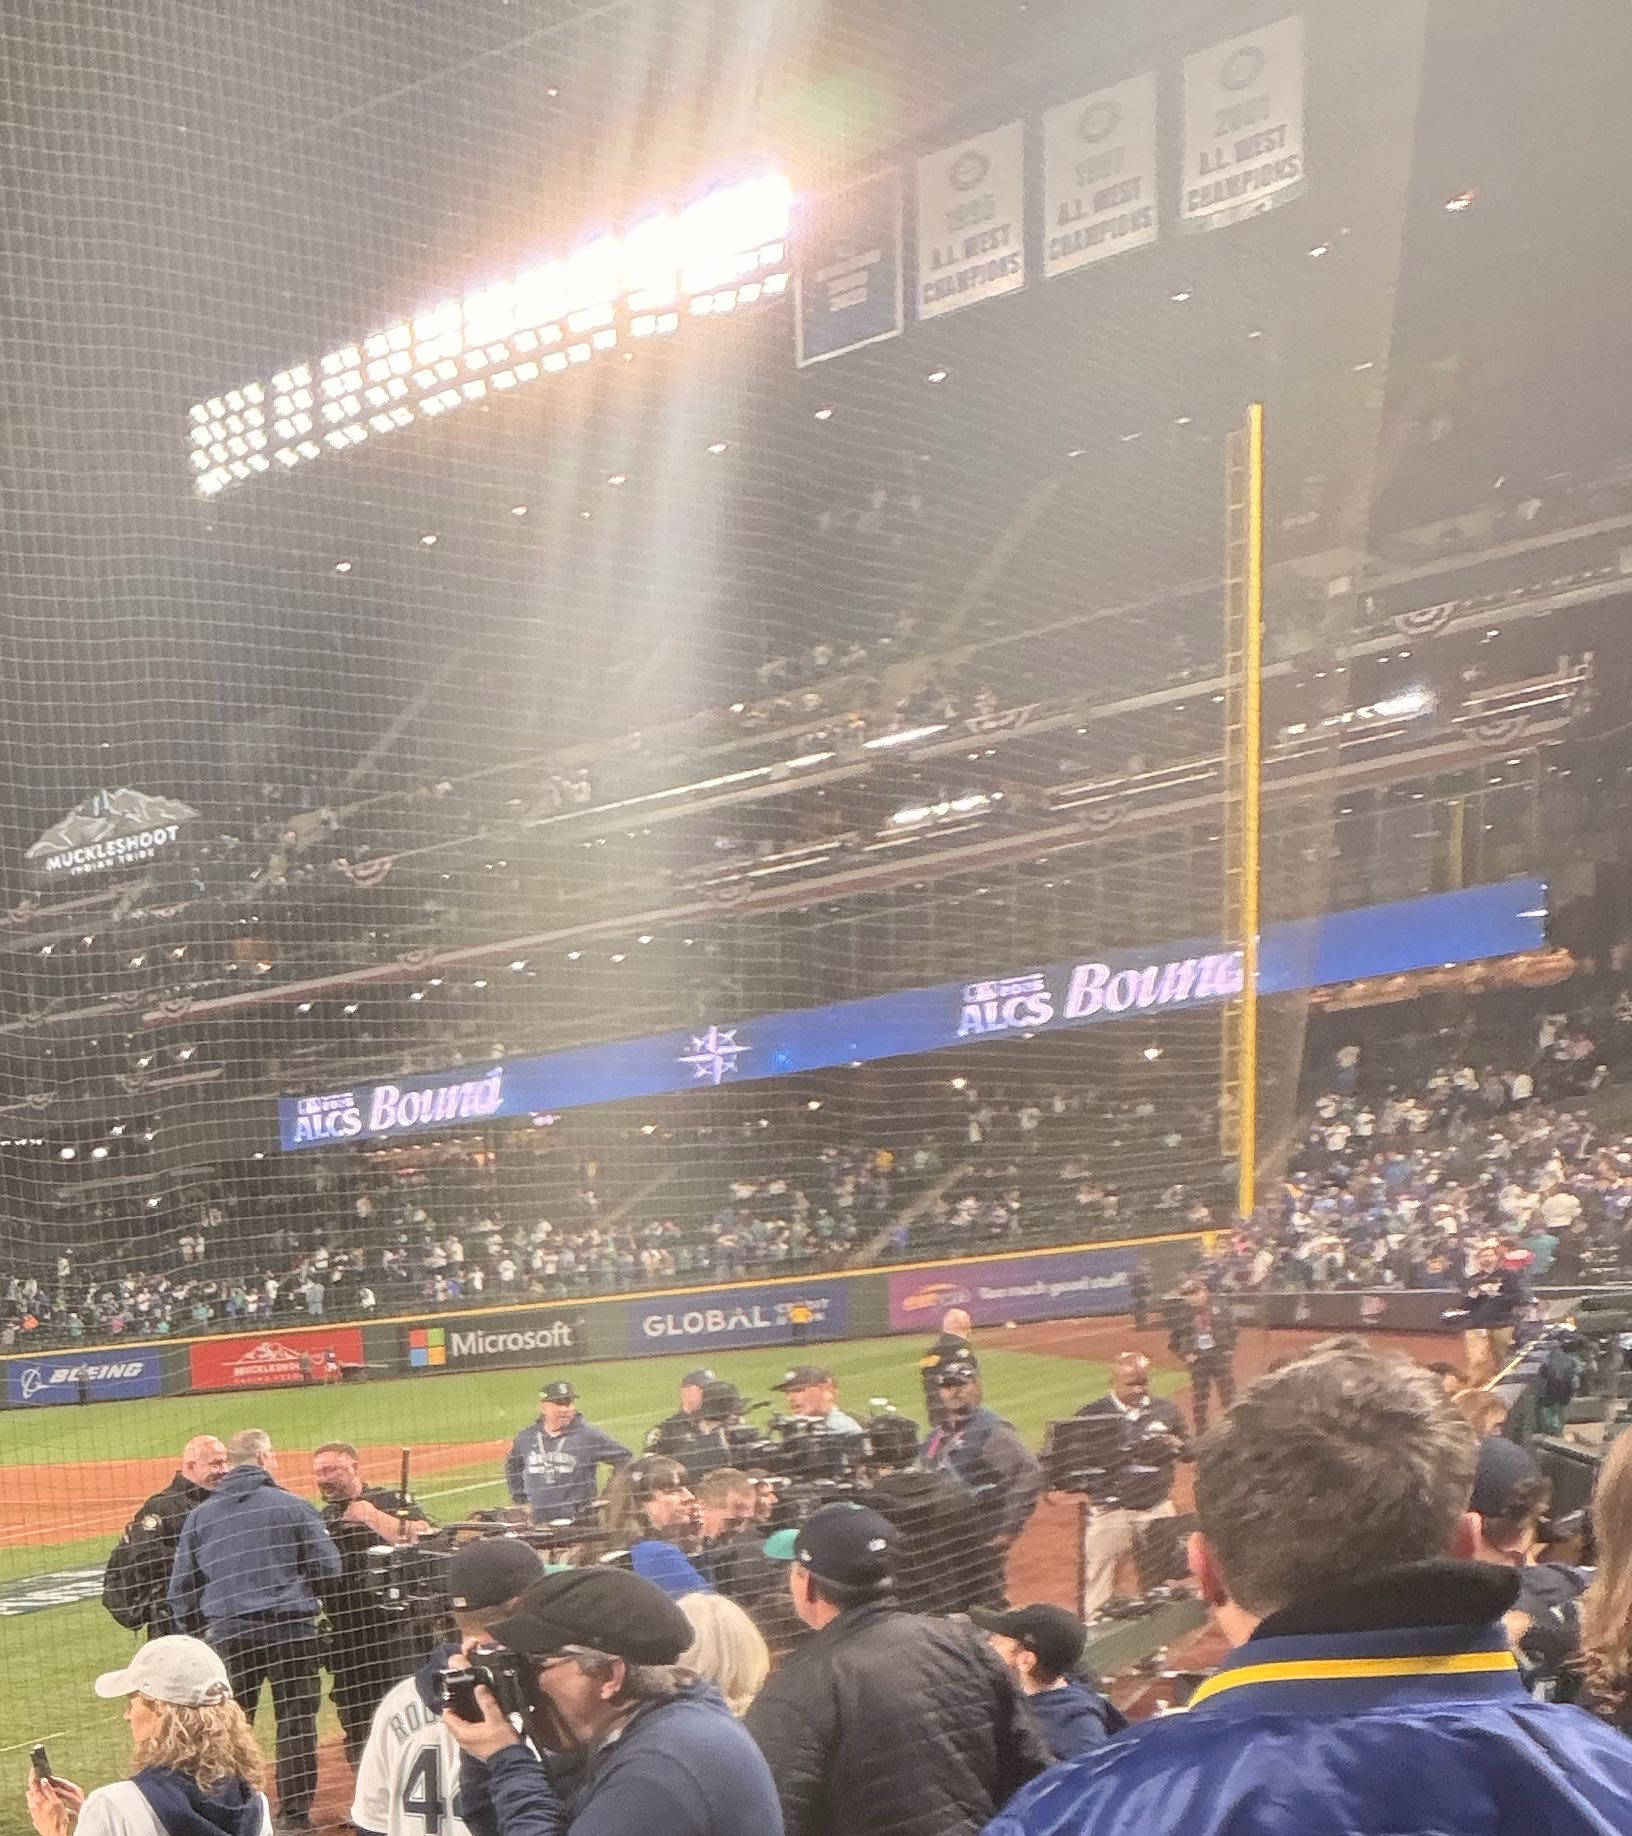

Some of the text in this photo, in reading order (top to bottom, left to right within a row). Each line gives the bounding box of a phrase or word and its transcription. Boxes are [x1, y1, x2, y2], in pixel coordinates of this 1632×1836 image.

[45, 825, 180, 871] MUCKLESHOOT
[956, 991, 1055, 1038] ALCS
[293, 1066, 505, 1143] ALCS Bound
[450, 1320, 572, 1357] Microsoft
[643, 1305, 770, 1338] GLOBAL
